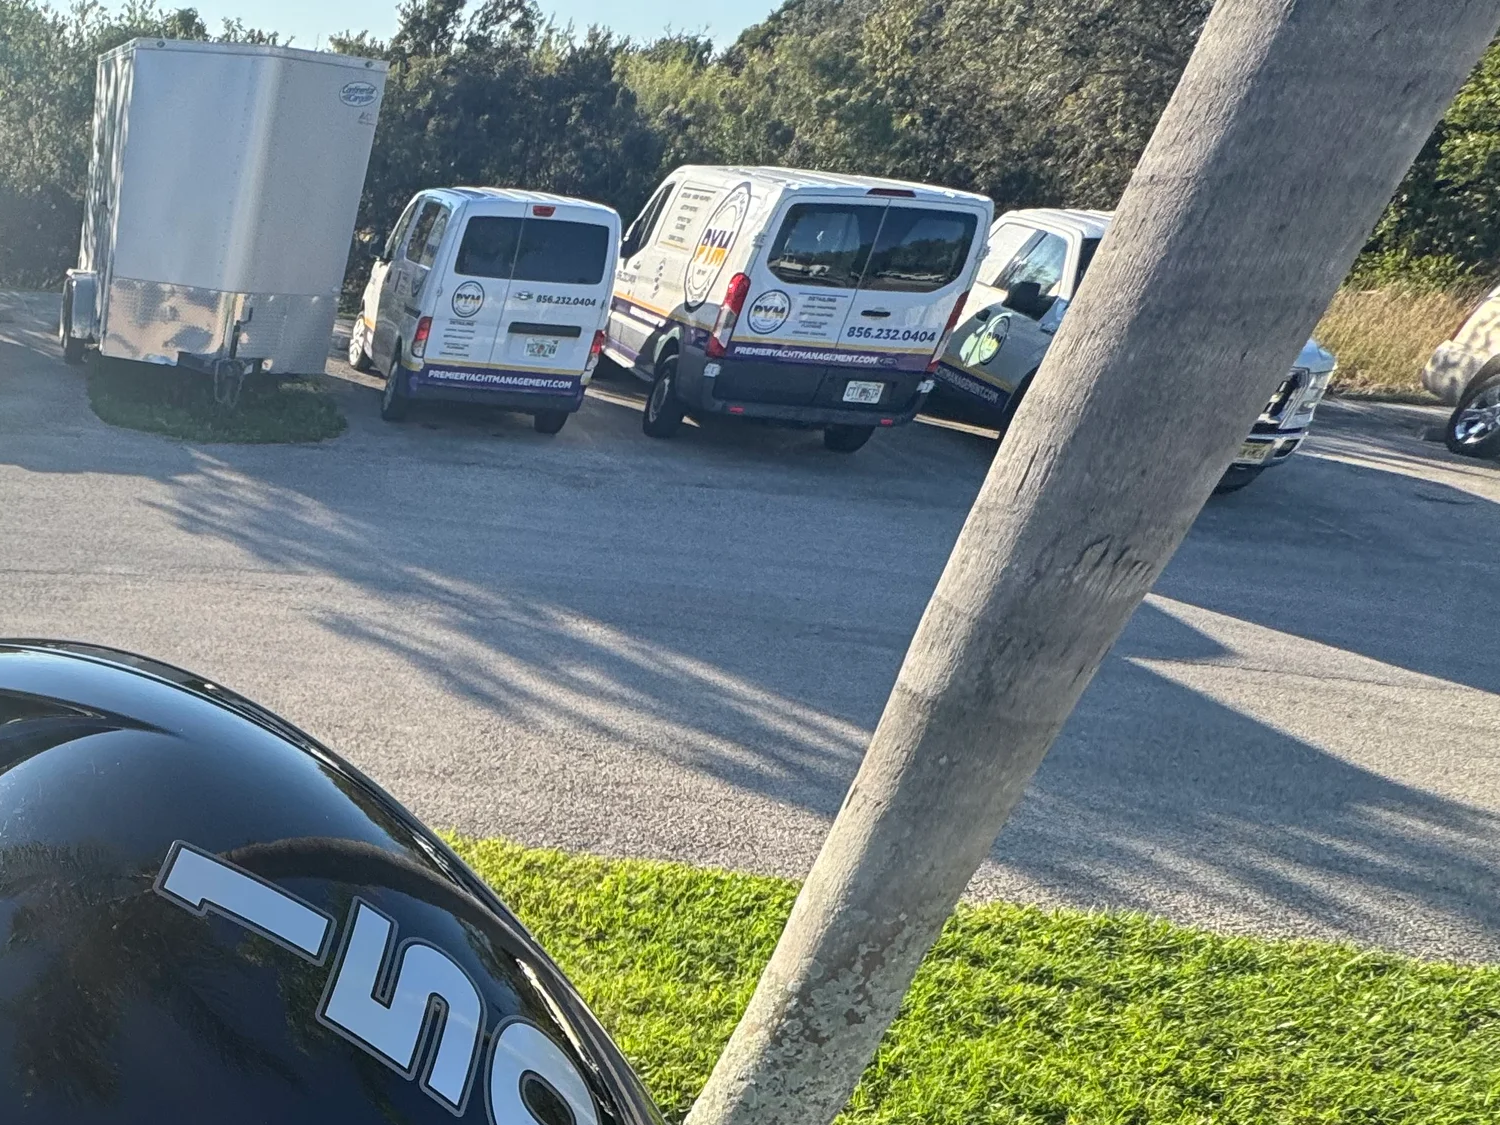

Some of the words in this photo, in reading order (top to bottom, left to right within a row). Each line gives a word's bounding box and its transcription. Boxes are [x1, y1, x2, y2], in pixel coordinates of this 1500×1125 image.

[536, 295, 597, 306] 856.232.0404
[846, 327, 937, 343] 856.232.0404
[734, 346, 879, 365] PREMIERYACHTMANAGEMENT.COM
[428, 370, 573, 389] PREMIERYACHTMANAGEMENT.COM
